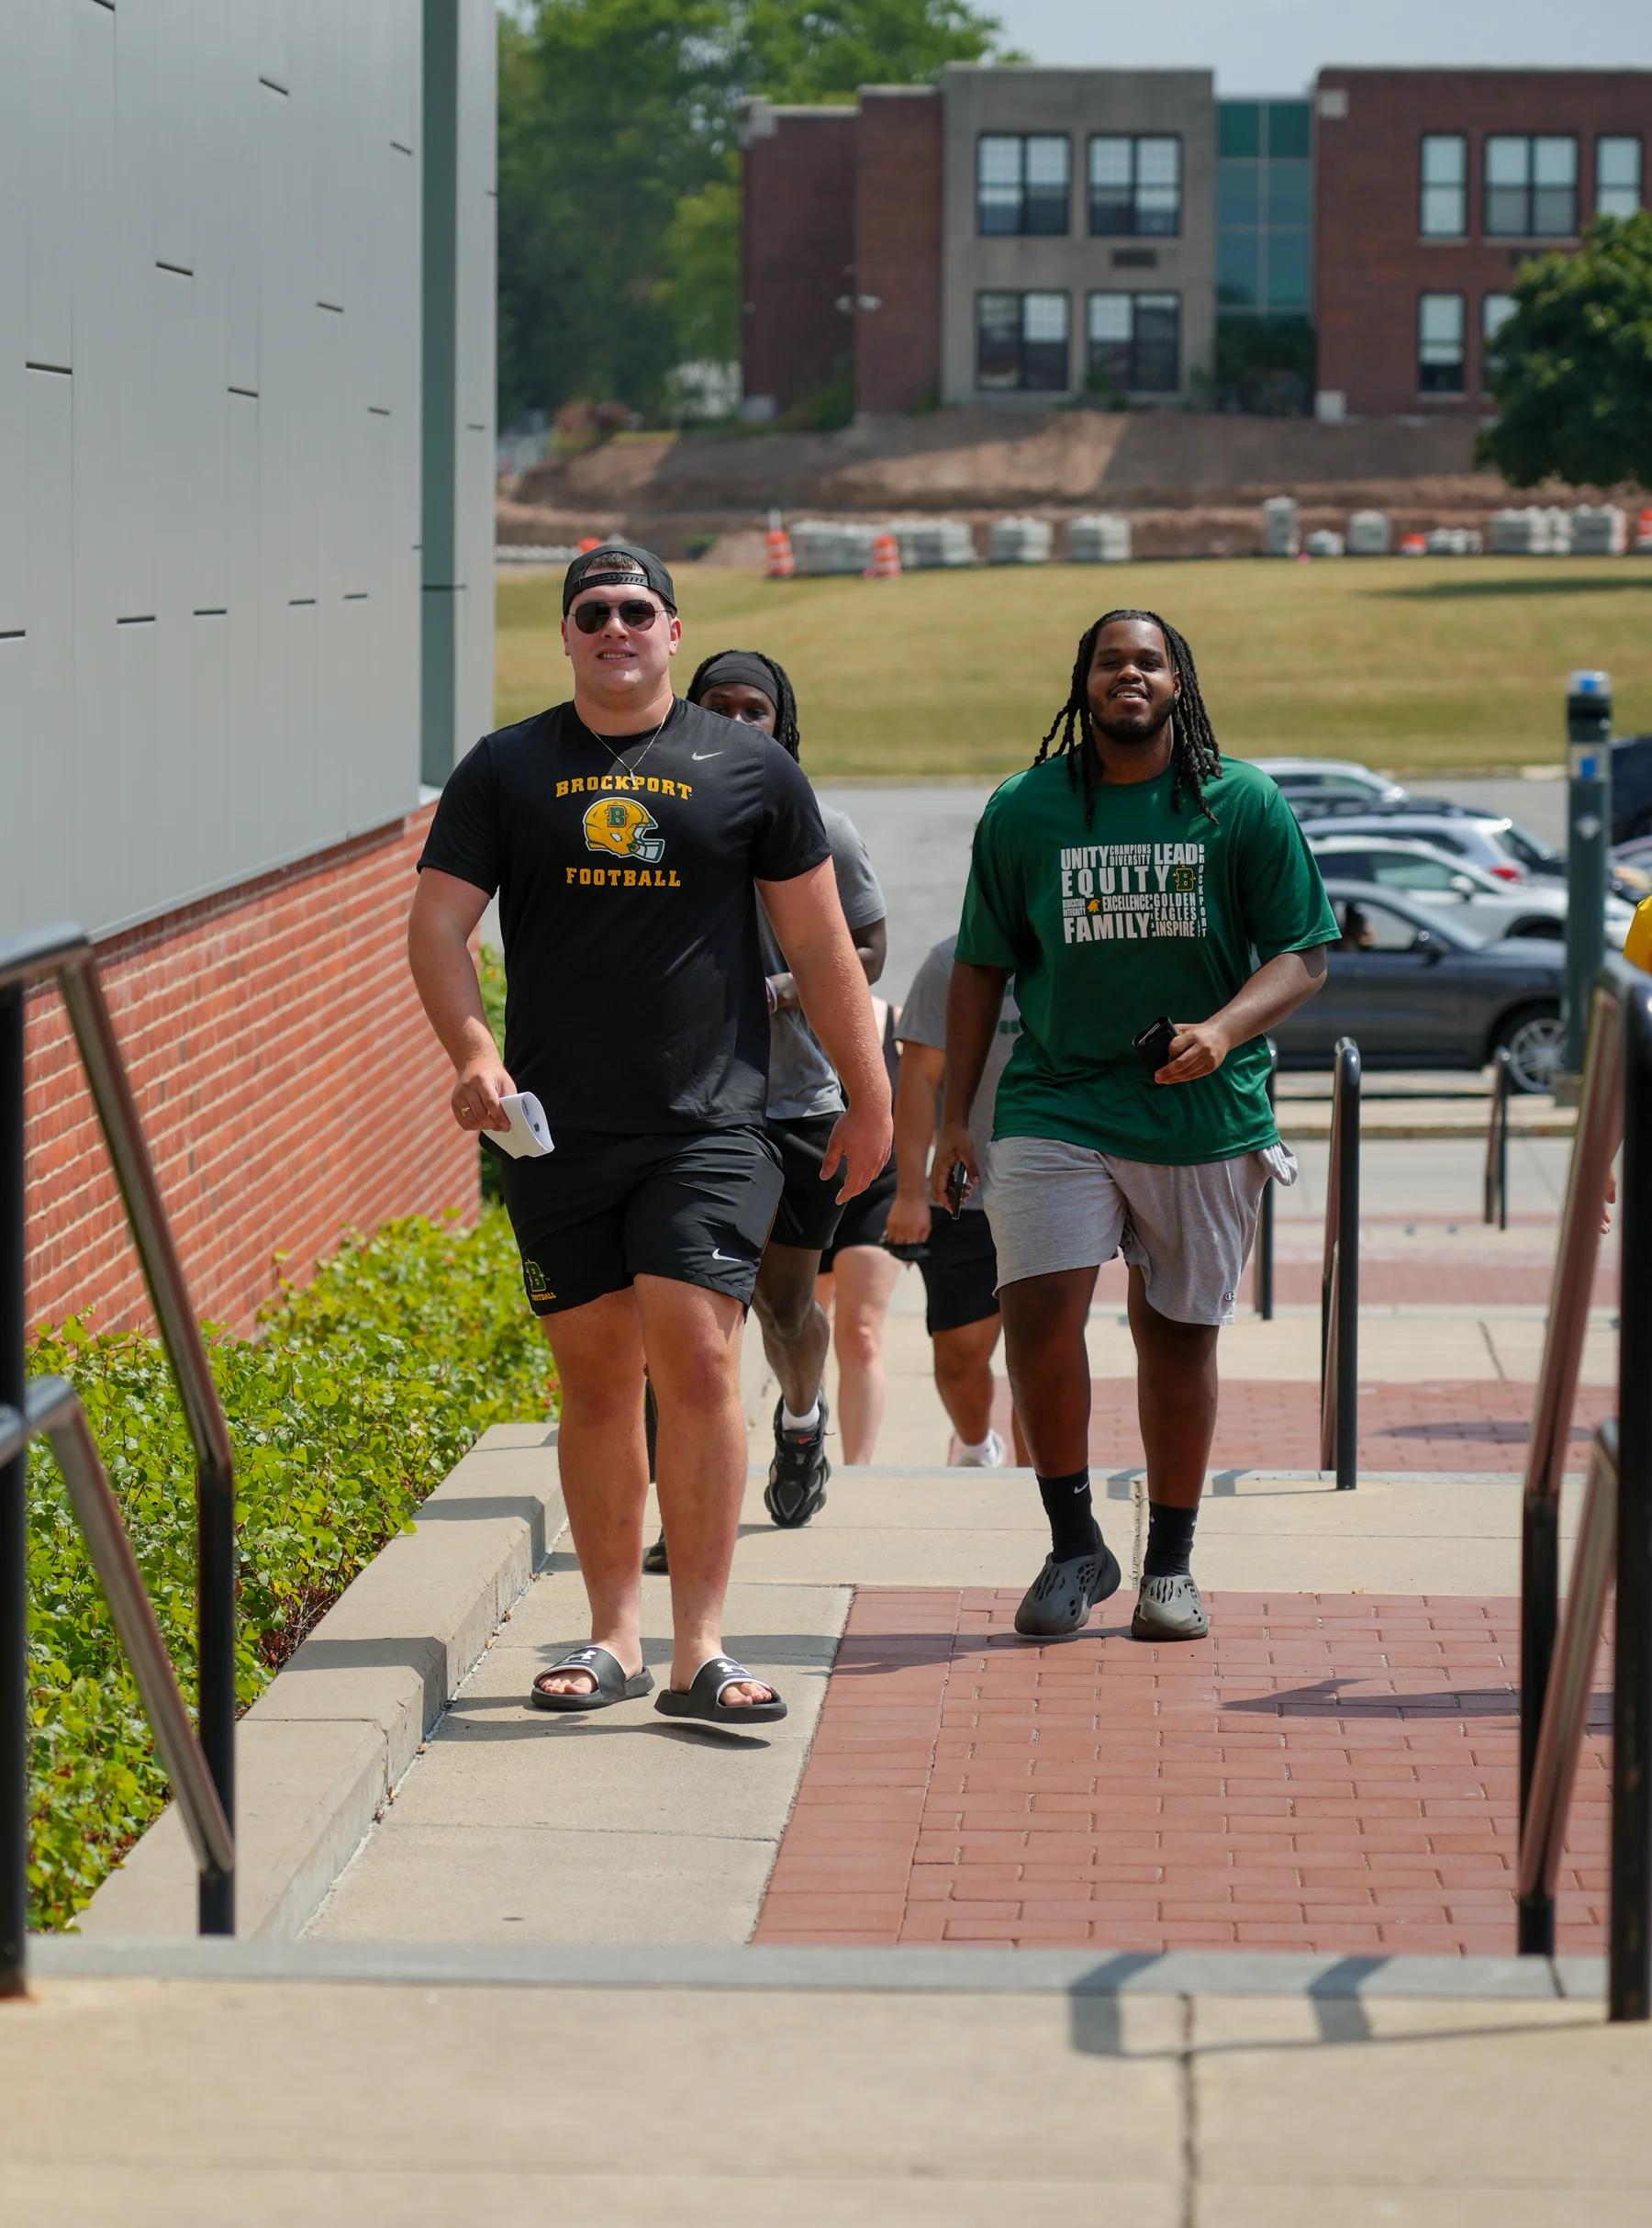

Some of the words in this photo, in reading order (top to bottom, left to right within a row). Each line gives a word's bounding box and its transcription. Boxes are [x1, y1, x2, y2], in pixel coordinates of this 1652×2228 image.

[555, 775, 693, 801] BROCKPORT
[605, 802, 629, 828] B
[1060, 845, 1111, 870] UNITY
[1110, 844, 1152, 856] CHAMPIONS
[1110, 854, 1152, 867] DIVERSITY
[1154, 843, 1199, 865] LEAD
[565, 867, 681, 888] FOOTBALL
[1061, 865, 1171, 899] EQUITY
[1173, 865, 1197, 891] B
[1154, 892, 1196, 907] GOLDEN
[1198, 844, 1207, 937] BROCKPORT
[1102, 893, 1150, 912] EXCELLENCE
[1155, 906, 1197, 921] EAGLES
[1063, 912, 1151, 944] FAMILY
[1155, 920, 1195, 937] INSPIRE
